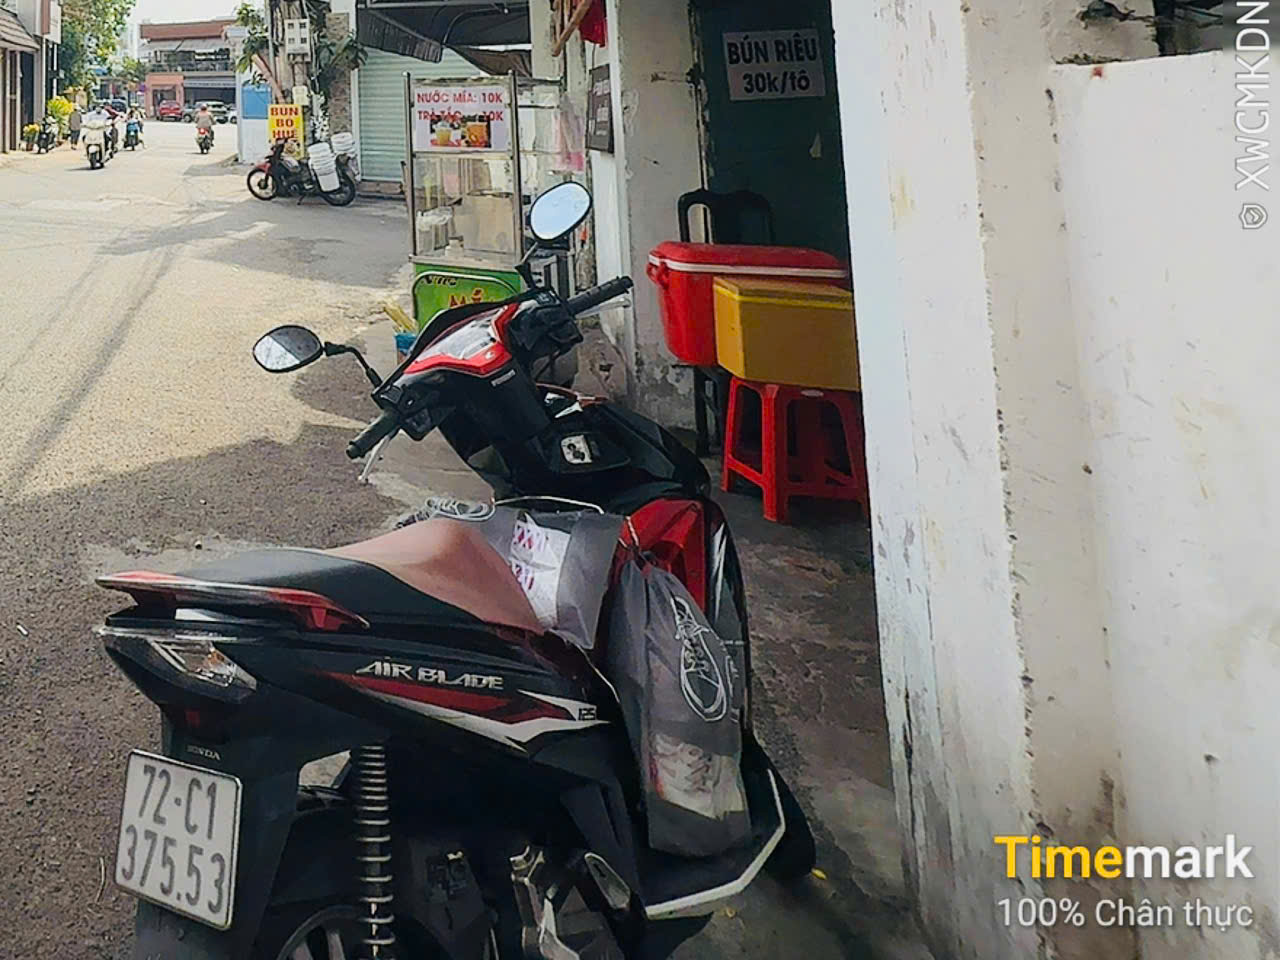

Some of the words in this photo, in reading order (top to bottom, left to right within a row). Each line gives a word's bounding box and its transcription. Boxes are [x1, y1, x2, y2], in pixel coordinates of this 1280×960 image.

[727, 35, 769, 65] BÚN
[774, 32, 818, 63] RIÊU
[416, 90, 449, 103] NƯỚC
[482, 92, 503, 103] 10K
[742, 69, 811, 95] 30k/tô
[417, 667, 505, 690] BLADE
[139, 764, 218, 840] 72-C1
[122, 824, 226, 914] 375.53
